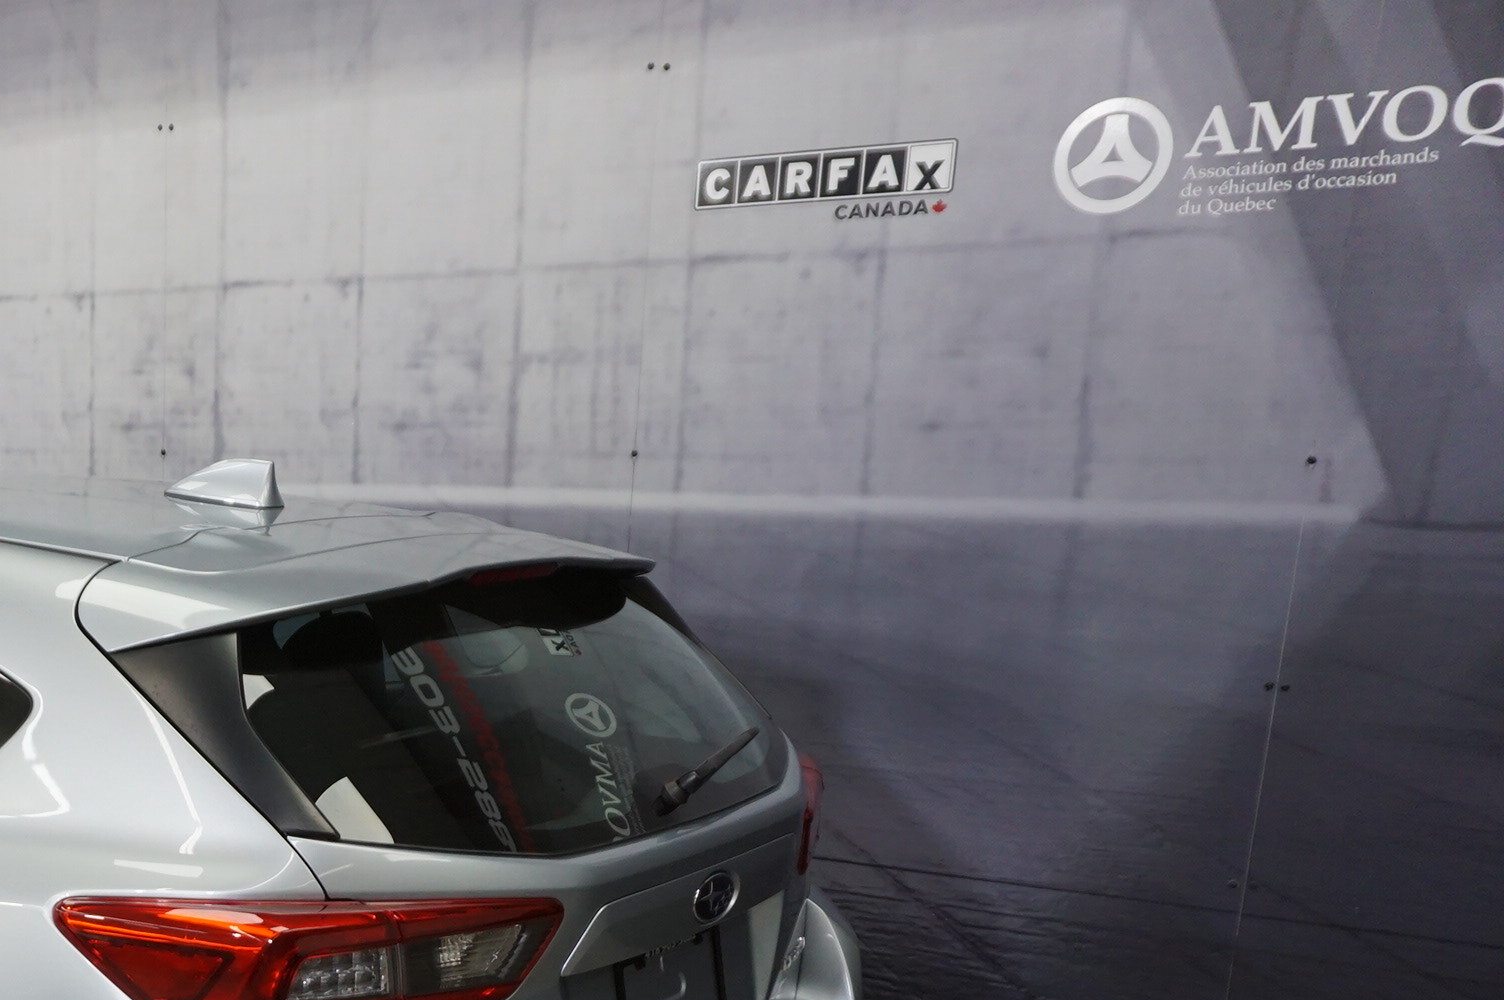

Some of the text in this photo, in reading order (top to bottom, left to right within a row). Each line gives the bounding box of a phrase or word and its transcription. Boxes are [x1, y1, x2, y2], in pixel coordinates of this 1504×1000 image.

[1184, 77, 1504, 158] AMVOQ
[705, 154, 946, 201] CARFAX
[1183, 147, 1439, 180] Association des marchands
[1180, 171, 1398, 198] de véhicules d'occasion
[834, 199, 929, 220] CANADA
[1178, 196, 1276, 216] du Quebec
